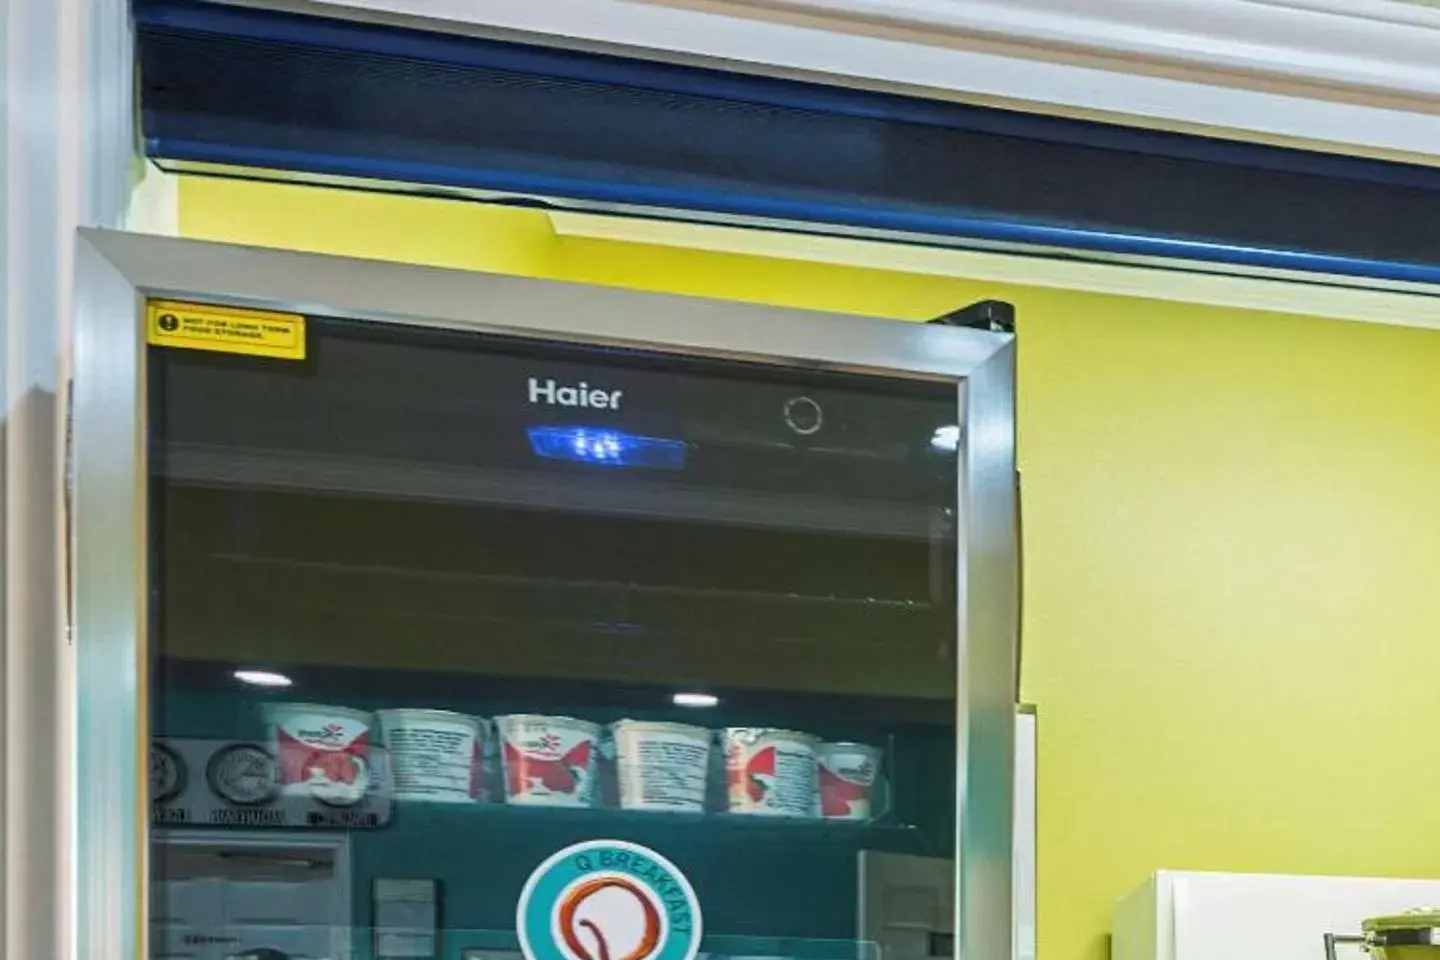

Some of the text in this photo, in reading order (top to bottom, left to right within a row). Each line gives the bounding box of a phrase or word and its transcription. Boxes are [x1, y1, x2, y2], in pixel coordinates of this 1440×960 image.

[528, 377, 622, 410] Haier
[575, 851, 692, 934] Q BREAKFAST
